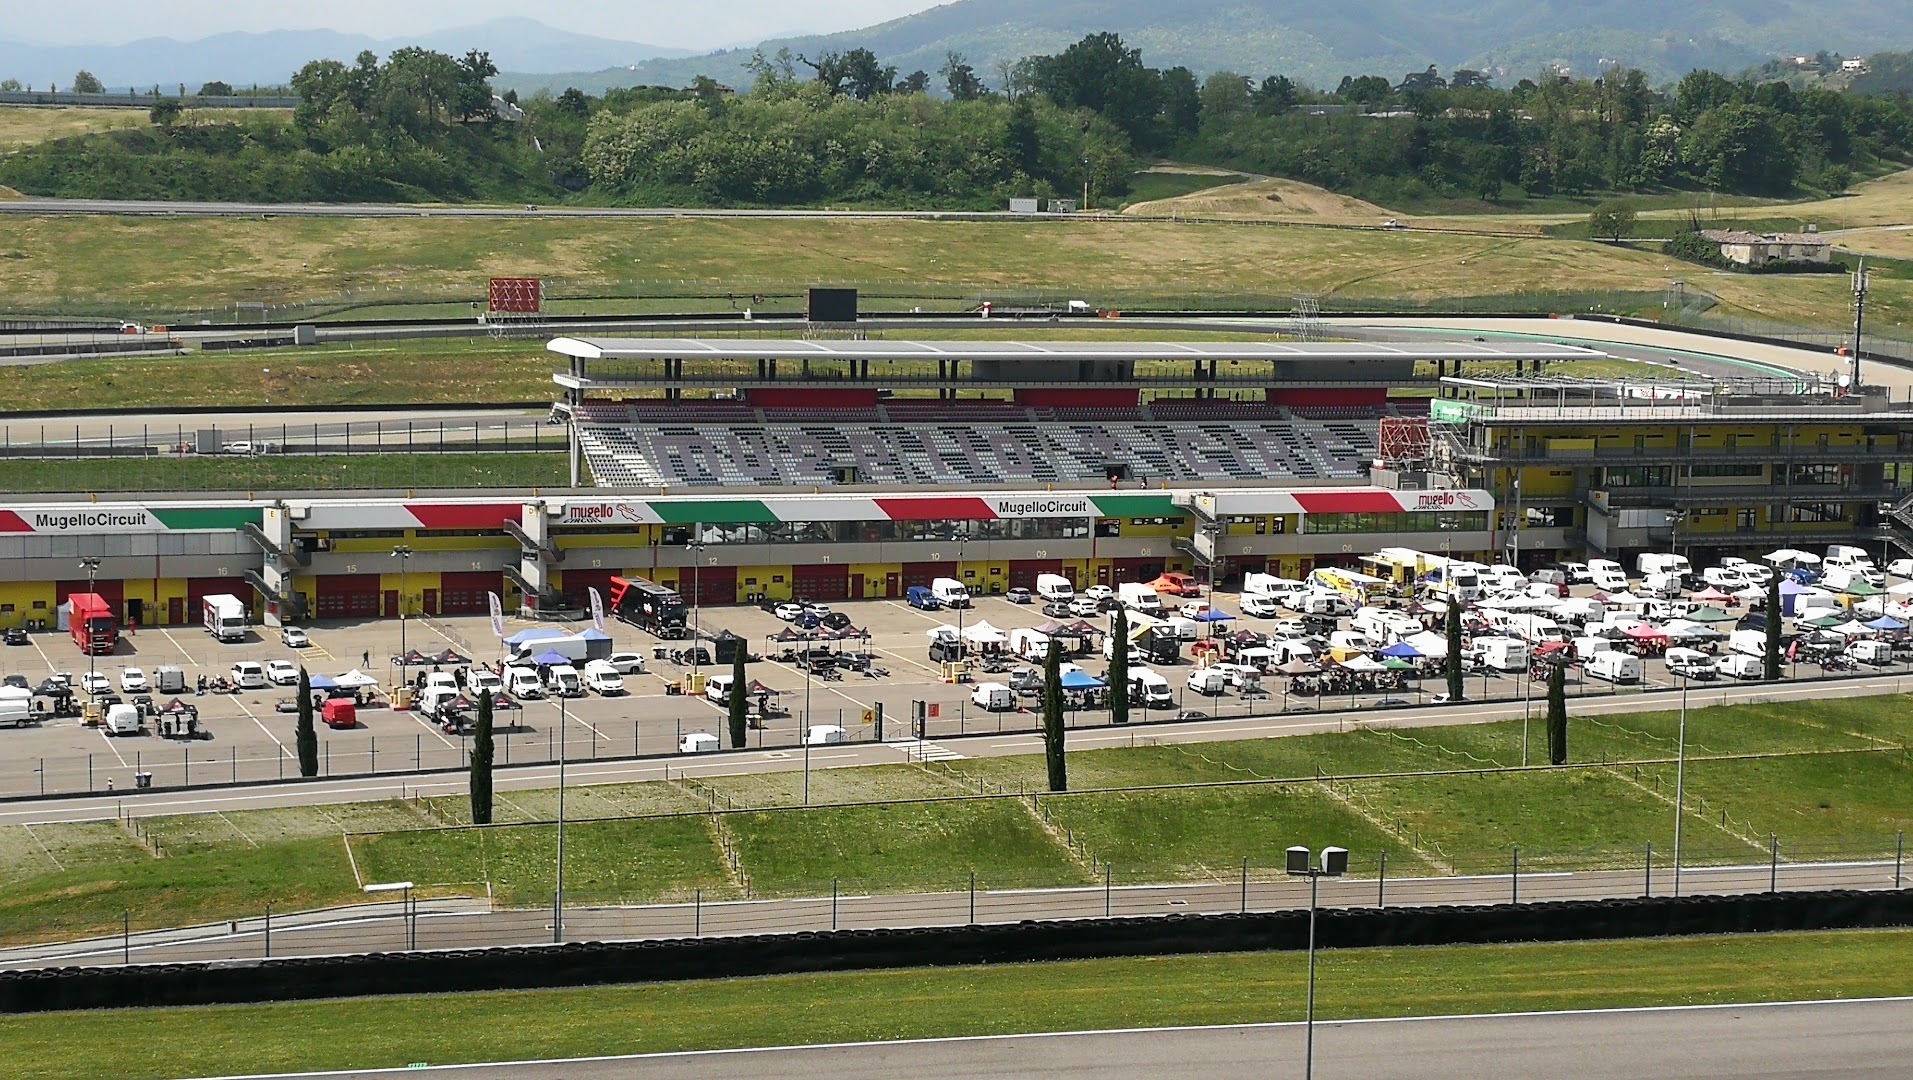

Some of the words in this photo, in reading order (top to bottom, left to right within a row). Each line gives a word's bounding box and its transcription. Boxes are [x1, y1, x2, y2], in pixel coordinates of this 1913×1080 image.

[1419, 492, 1454, 505] mugello
[571, 503, 613, 518] mugello
[999, 501, 1087, 515] MugelloCircuit
[36, 512, 147, 529] MugelloCircuit
[1036, 550, 1046, 558] 09
[1141, 548, 1151, 556] 08
[1242, 546, 1252, 554] 07
[931, 552, 940, 560] 10
[592, 560, 602, 568] 13
[708, 557, 718, 565] 12
[346, 564, 357, 573] 15
[472, 562, 480, 570] 14
[218, 567, 228, 575] 16
[864, 711, 873, 722] 4
